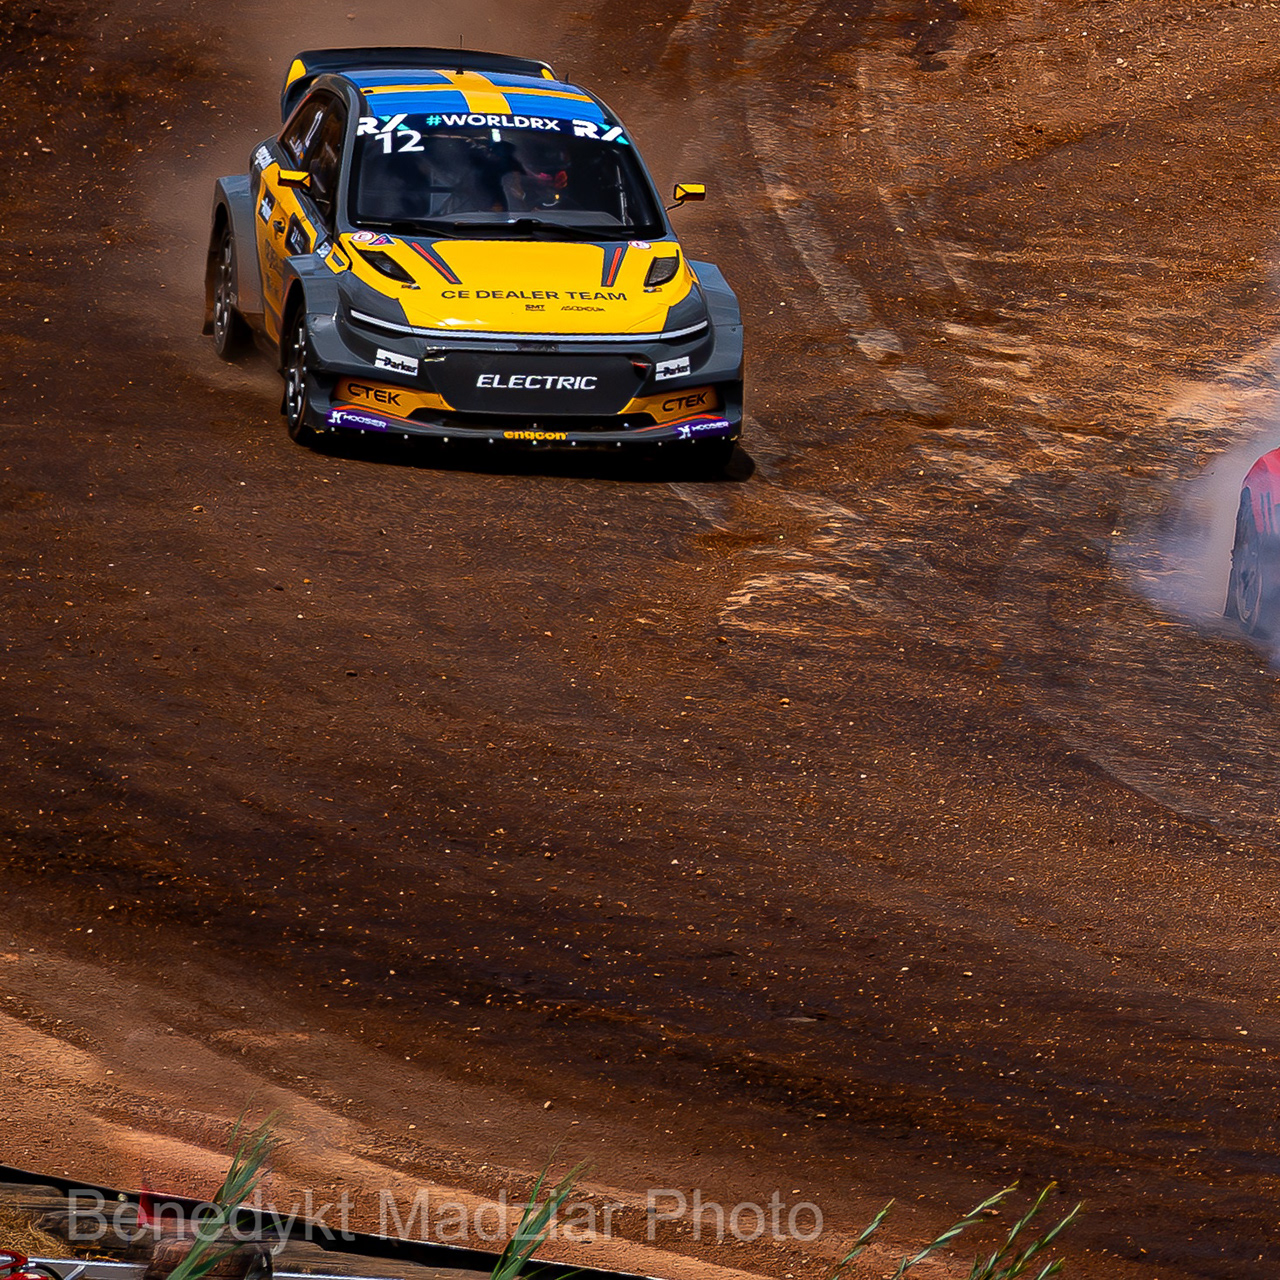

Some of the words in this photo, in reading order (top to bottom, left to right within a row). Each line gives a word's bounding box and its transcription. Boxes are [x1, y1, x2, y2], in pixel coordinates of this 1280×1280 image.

[425, 114, 562, 131] #WORLDRX
[374, 130, 425, 154] 12
[441, 290, 470, 299] CE
[476, 290, 560, 300] DEALER
[565, 291, 627, 301] TEAM
[383, 356, 418, 373] Parker
[476, 374, 598, 390] ELECTRIC
[347, 382, 402, 407] CTEK
[661, 391, 709, 413] CTEK
